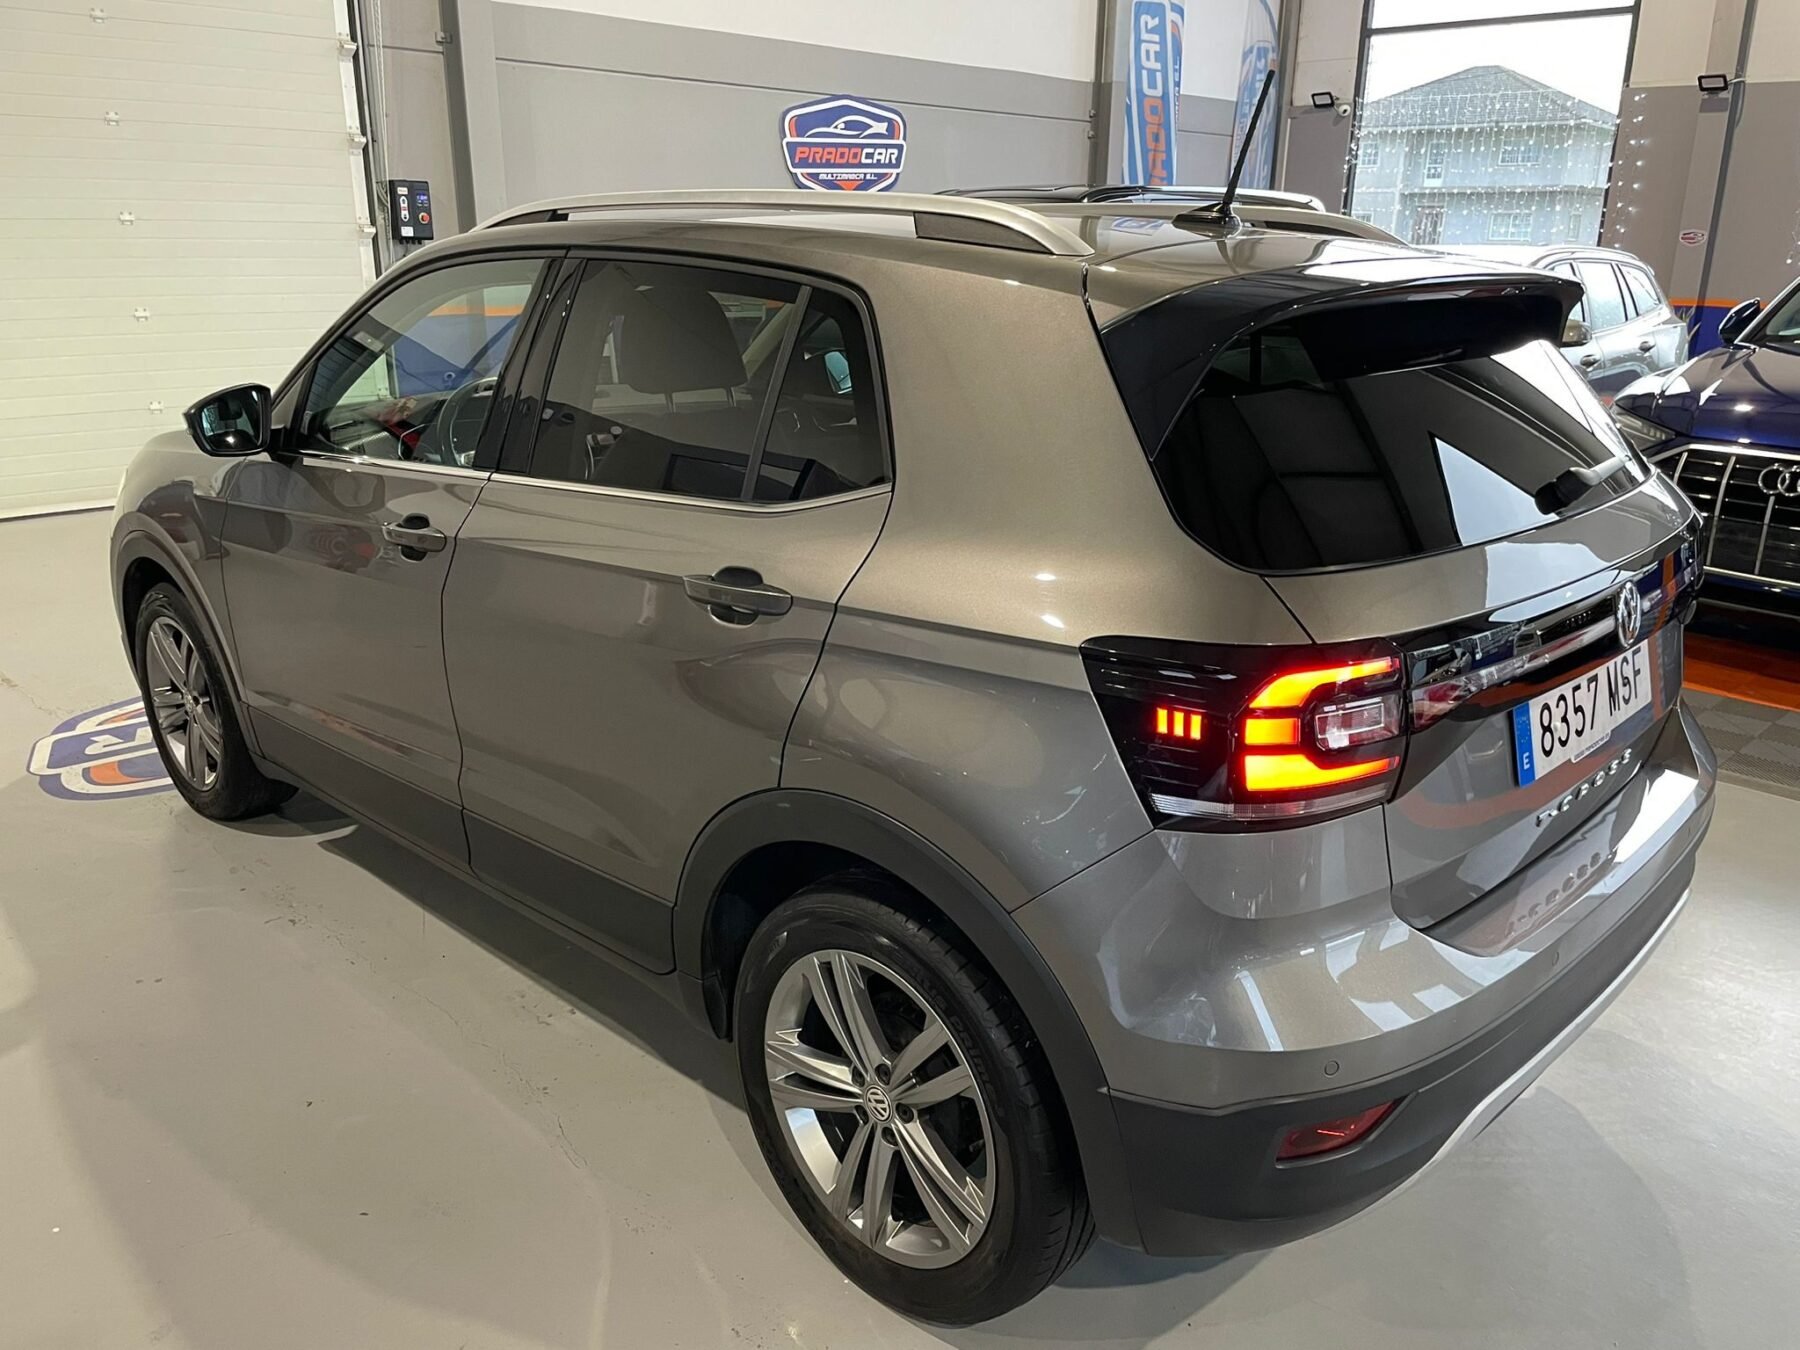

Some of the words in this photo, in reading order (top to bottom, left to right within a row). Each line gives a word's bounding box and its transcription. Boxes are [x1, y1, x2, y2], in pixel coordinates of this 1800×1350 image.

[794, 146, 899, 164] PRADOCAR
[1539, 673, 1599, 758] 8357
[1606, 646, 1642, 717] MSF
[1522, 751, 1531, 770] E
